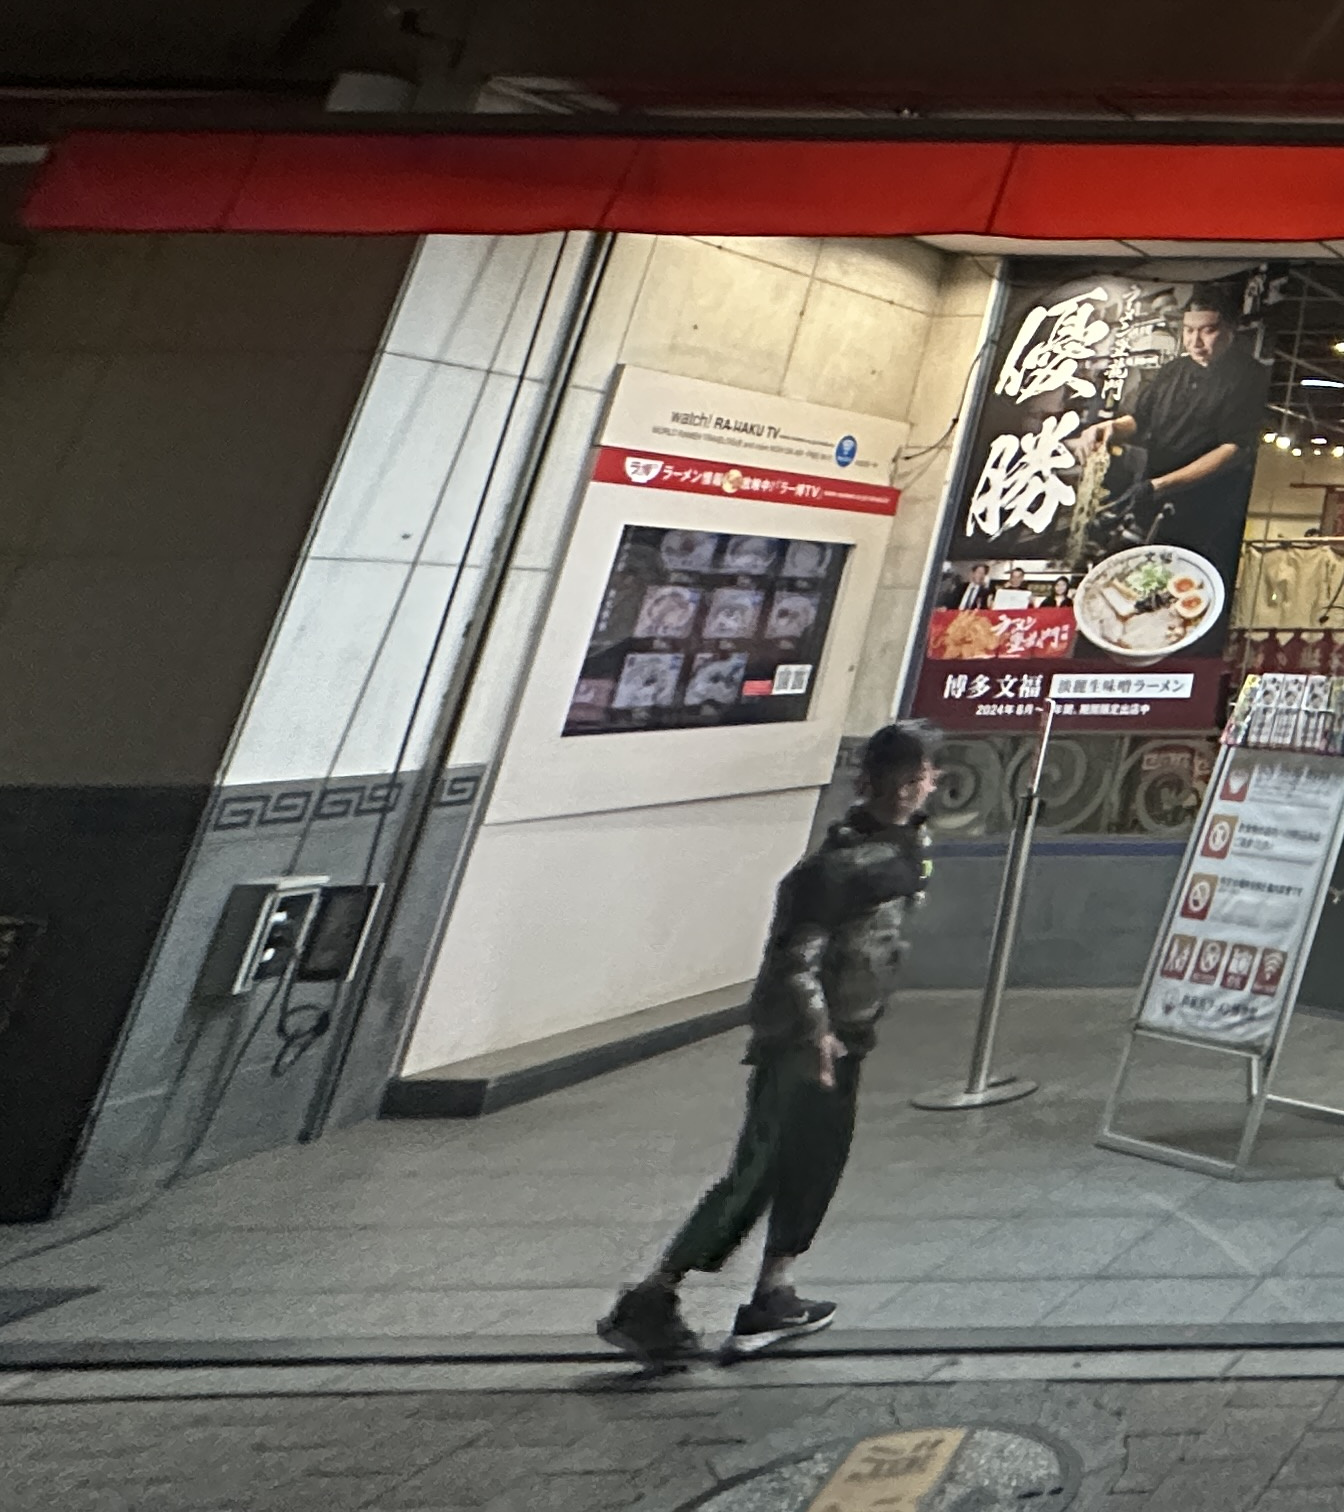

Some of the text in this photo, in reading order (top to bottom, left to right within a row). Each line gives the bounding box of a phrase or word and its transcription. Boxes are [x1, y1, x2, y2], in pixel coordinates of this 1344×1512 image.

[966, 287, 1109, 542] 優勝
[767, 425, 781, 439] TV
[943, 673, 1044, 700] 博多文福
